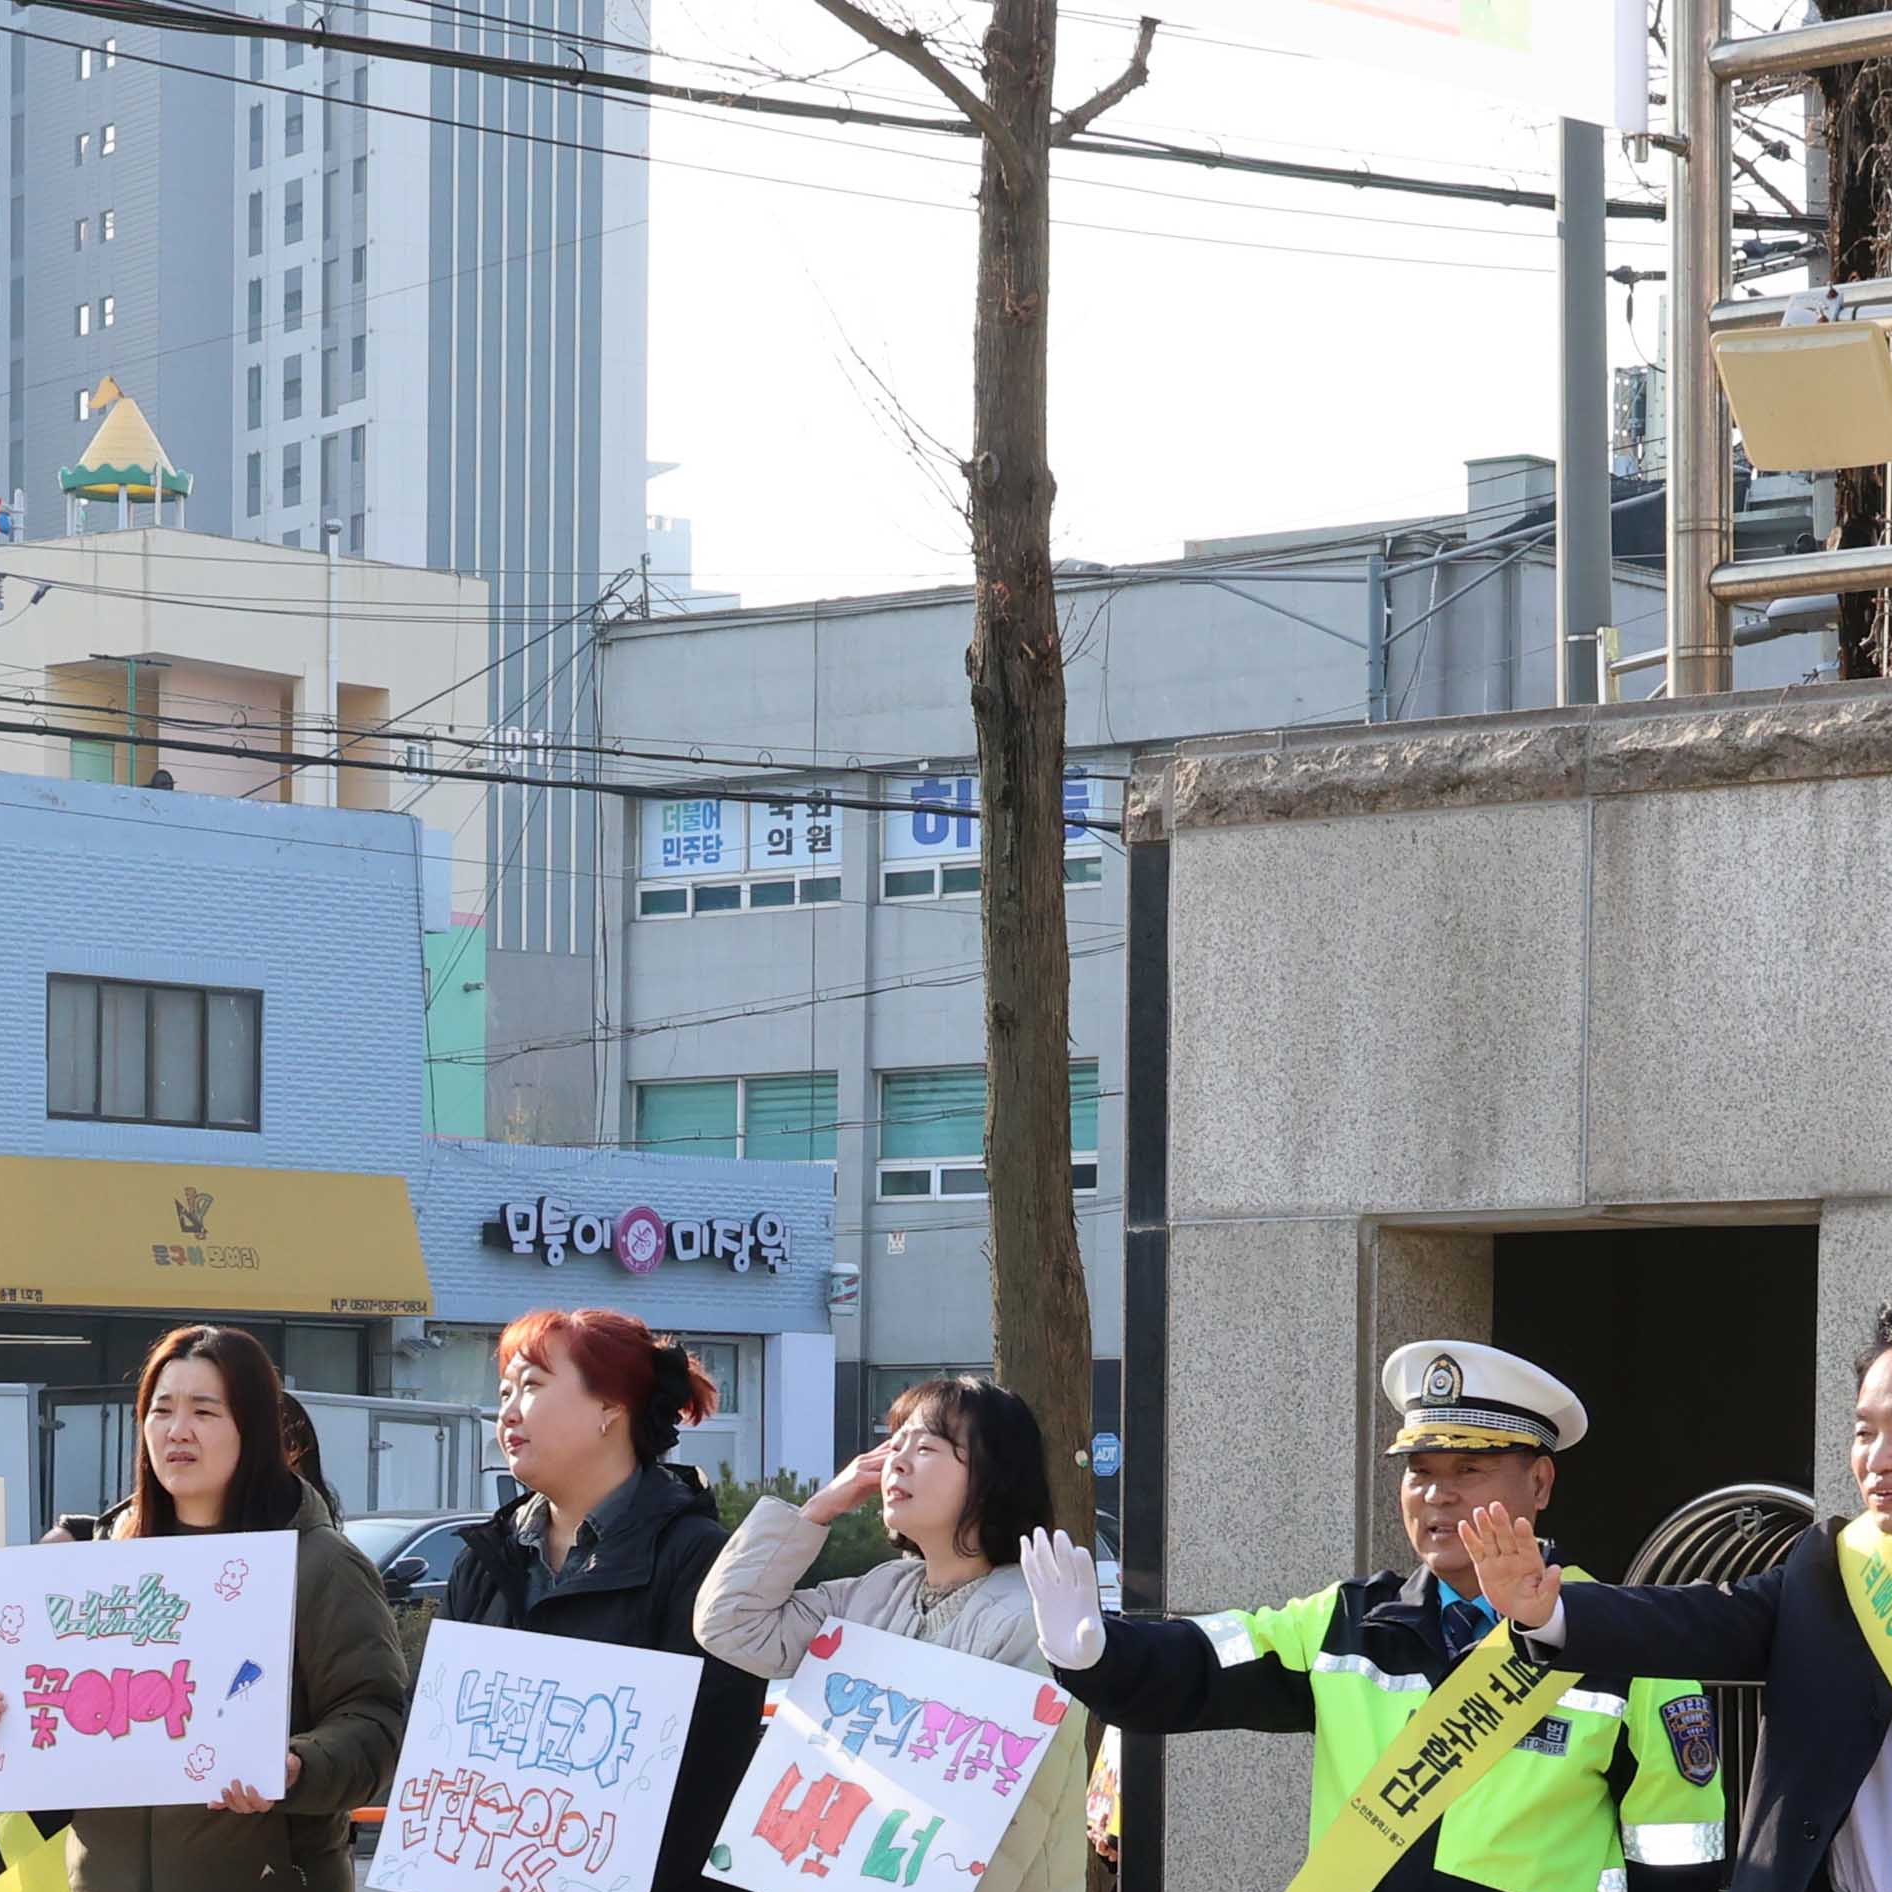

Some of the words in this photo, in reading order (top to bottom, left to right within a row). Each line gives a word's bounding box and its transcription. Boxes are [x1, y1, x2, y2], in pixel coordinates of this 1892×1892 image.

[661, 799, 722, 833] 더불어
[662, 834, 724, 868] 민주당
[766, 825, 832, 857] 의원
[671, 1212, 794, 1274] 미장원
[24, 1659, 196, 1750] 꽃이야
[1379, 1692, 1504, 1818] 준수합시다
[1533, 1738, 1566, 1754] DRIVER
[860, 1808, 946, 1888] 너
